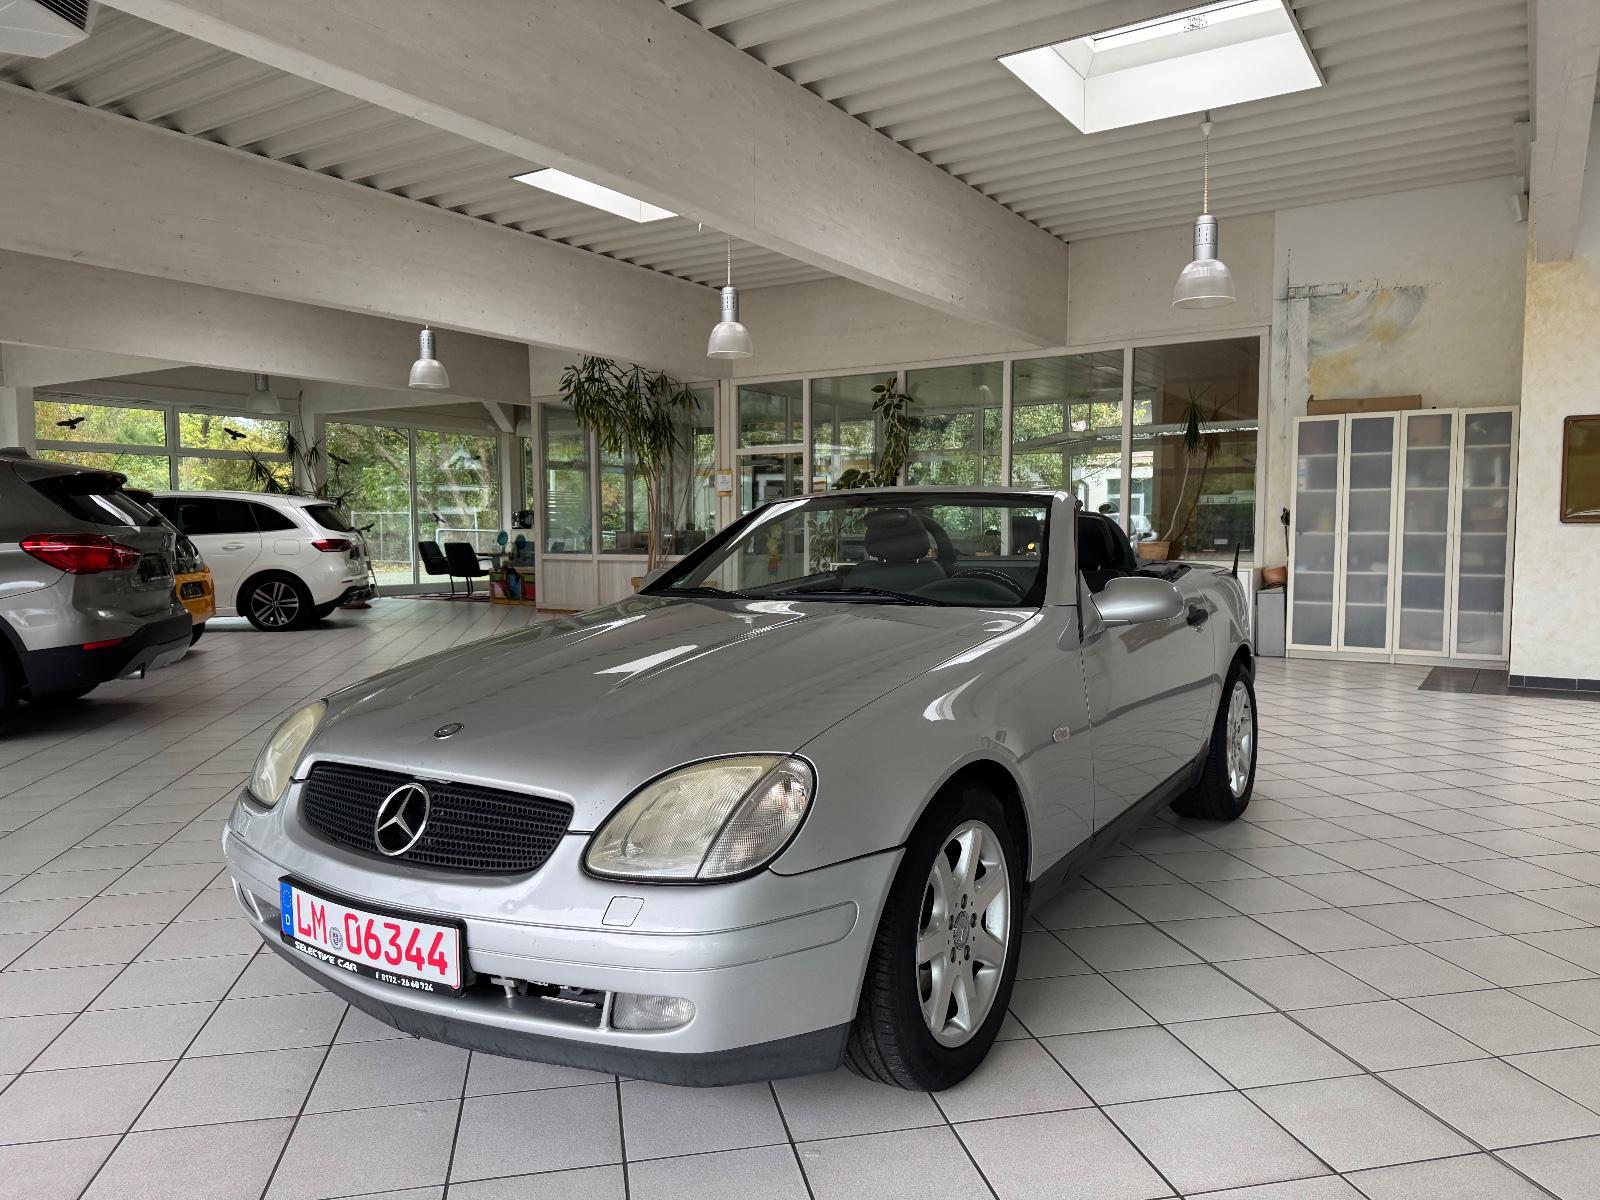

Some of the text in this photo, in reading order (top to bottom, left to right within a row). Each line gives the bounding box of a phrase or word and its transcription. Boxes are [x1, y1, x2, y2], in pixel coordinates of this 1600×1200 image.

[285, 893, 448, 976] D LM 06344
[294, 941, 358, 973] SELECTIVE CAR
